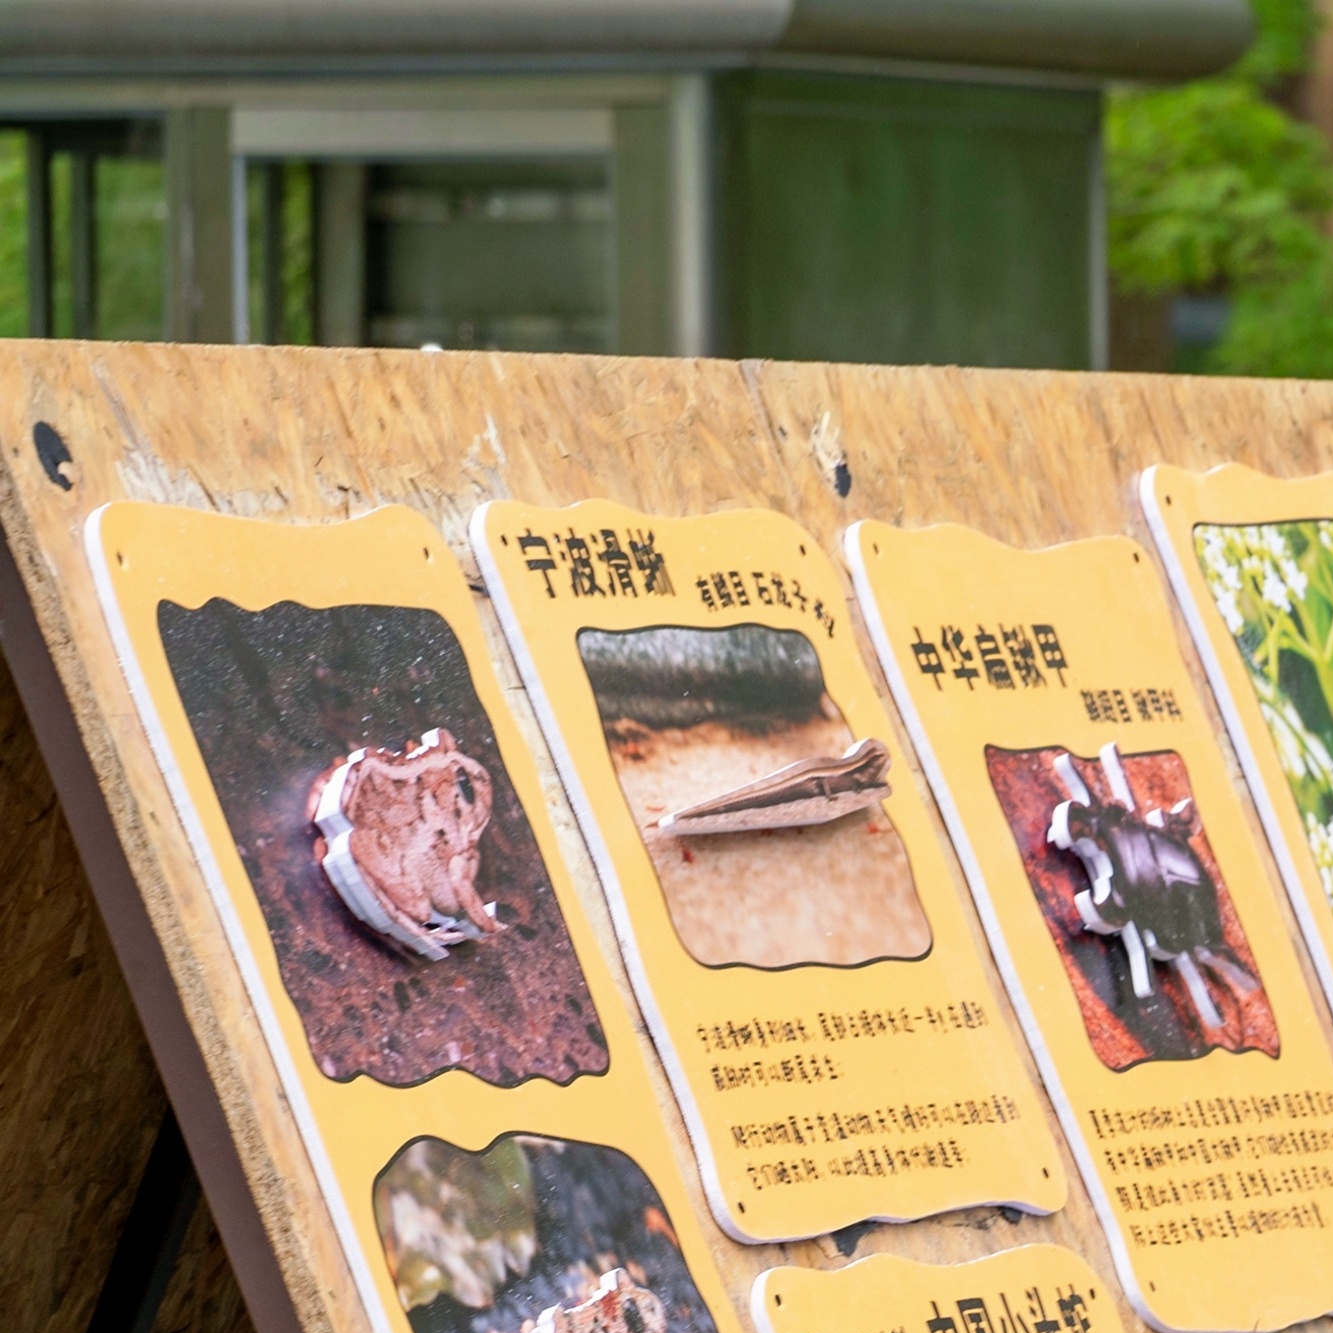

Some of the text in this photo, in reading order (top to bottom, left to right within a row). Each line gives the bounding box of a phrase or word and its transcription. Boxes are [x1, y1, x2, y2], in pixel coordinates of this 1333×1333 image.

[517, 527, 676, 599] 宁波滑蜥
[696, 571, 751, 612] 有鳞目
[911, 624, 1068, 691] 中华扁锹甲
